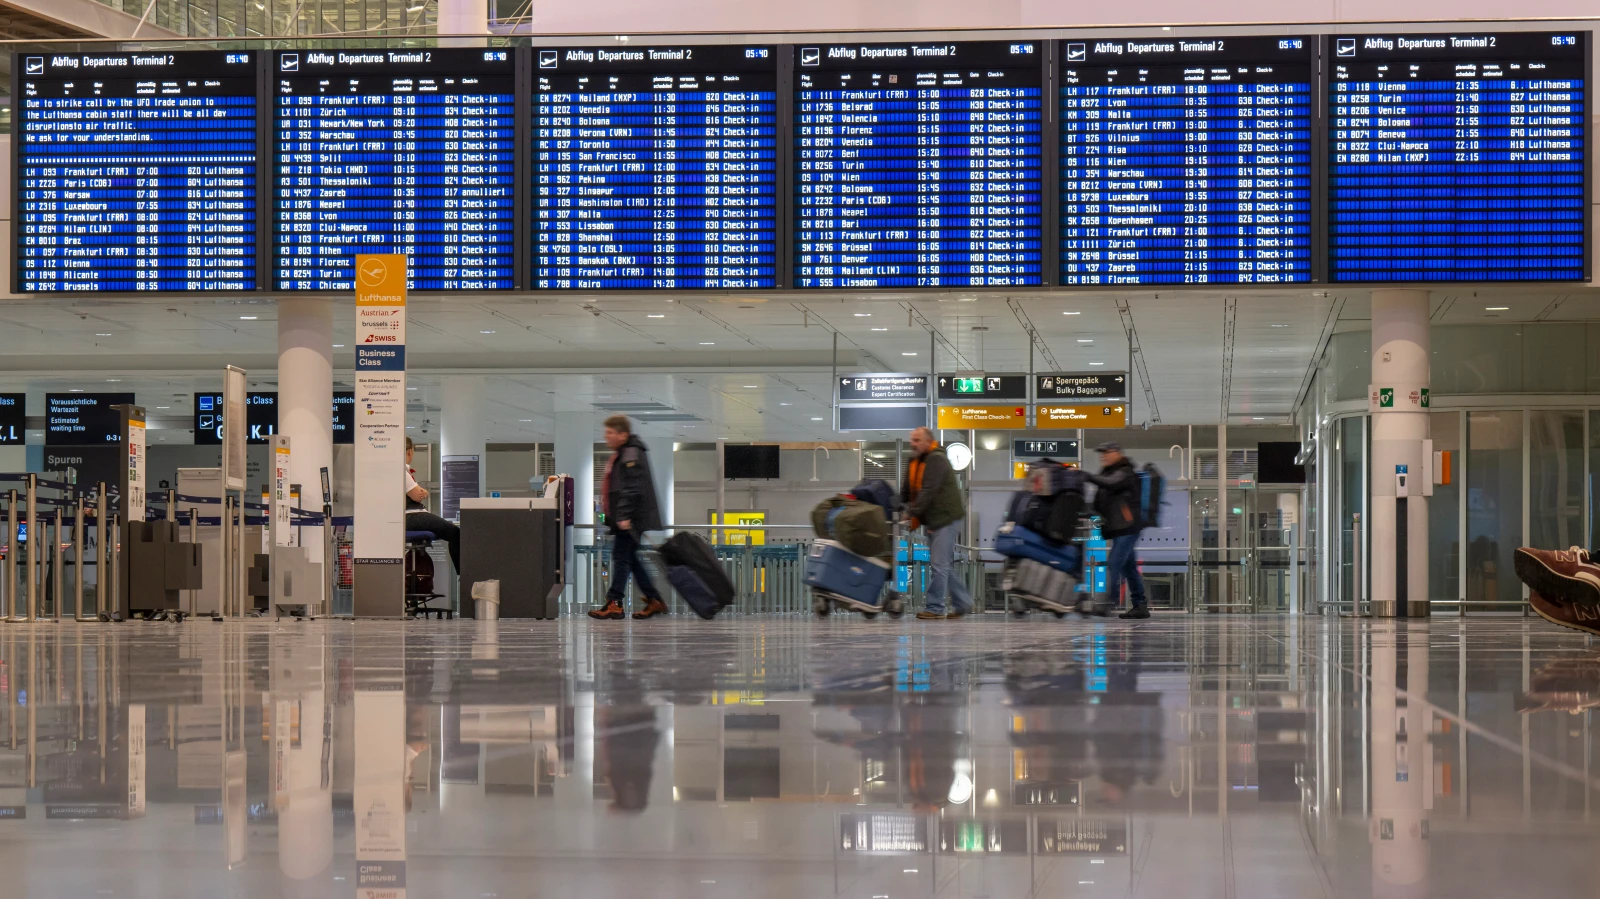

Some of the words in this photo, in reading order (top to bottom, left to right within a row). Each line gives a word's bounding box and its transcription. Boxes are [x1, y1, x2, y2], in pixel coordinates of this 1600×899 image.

[1279, 40, 1302, 49] 05:40
[1365, 38, 1393, 50] Abflug
[1398, 38, 1445, 50] Departures
[1450, 37, 1487, 47] Terminal
[1490, 37, 1495, 46] 2
[1552, 37, 1575, 45] 05:40
[1010, 45, 1033, 54] 05:40
[1095, 43, 1122, 54] Abflug
[1128, 43, 1174, 54] Departures
[1179, 41, 1215, 51] Terminal
[1218, 41, 1224, 50] 2
[566, 51, 593, 62] Abflug
[599, 50, 644, 62] Departures
[648, 50, 683, 59] Terminal
[686, 50, 692, 59] 2
[828, 48, 856, 59] Abflug
[861, 47, 907, 58] Departures
[912, 46, 947, 56] Terminal
[950, 46, 955, 55] 2
[52, 57, 78, 68] Abflug
[84, 56, 127, 68] Departures
[132, 56, 166, 65] Terminal
[169, 56, 174, 64] 2
[307, 54, 334, 65] Abflug
[339, 53, 384, 65] Departures
[388, 53, 423, 62] Terminal
[426, 53, 431, 62] 2
[1456, 94, 1478, 102] 21:40
[654, 140, 675, 148] 11:50
[918, 160, 939, 168] 15:40
[462, 188, 504, 196] annulliert
[1108, 240, 1135, 248] Zürich
[1185, 239, 1207, 247] 21:00
[1056, 377, 1099, 385] Sperrgepäck
[48, 455, 82, 466] Spuren
[1555, 550, 1575, 562] N
